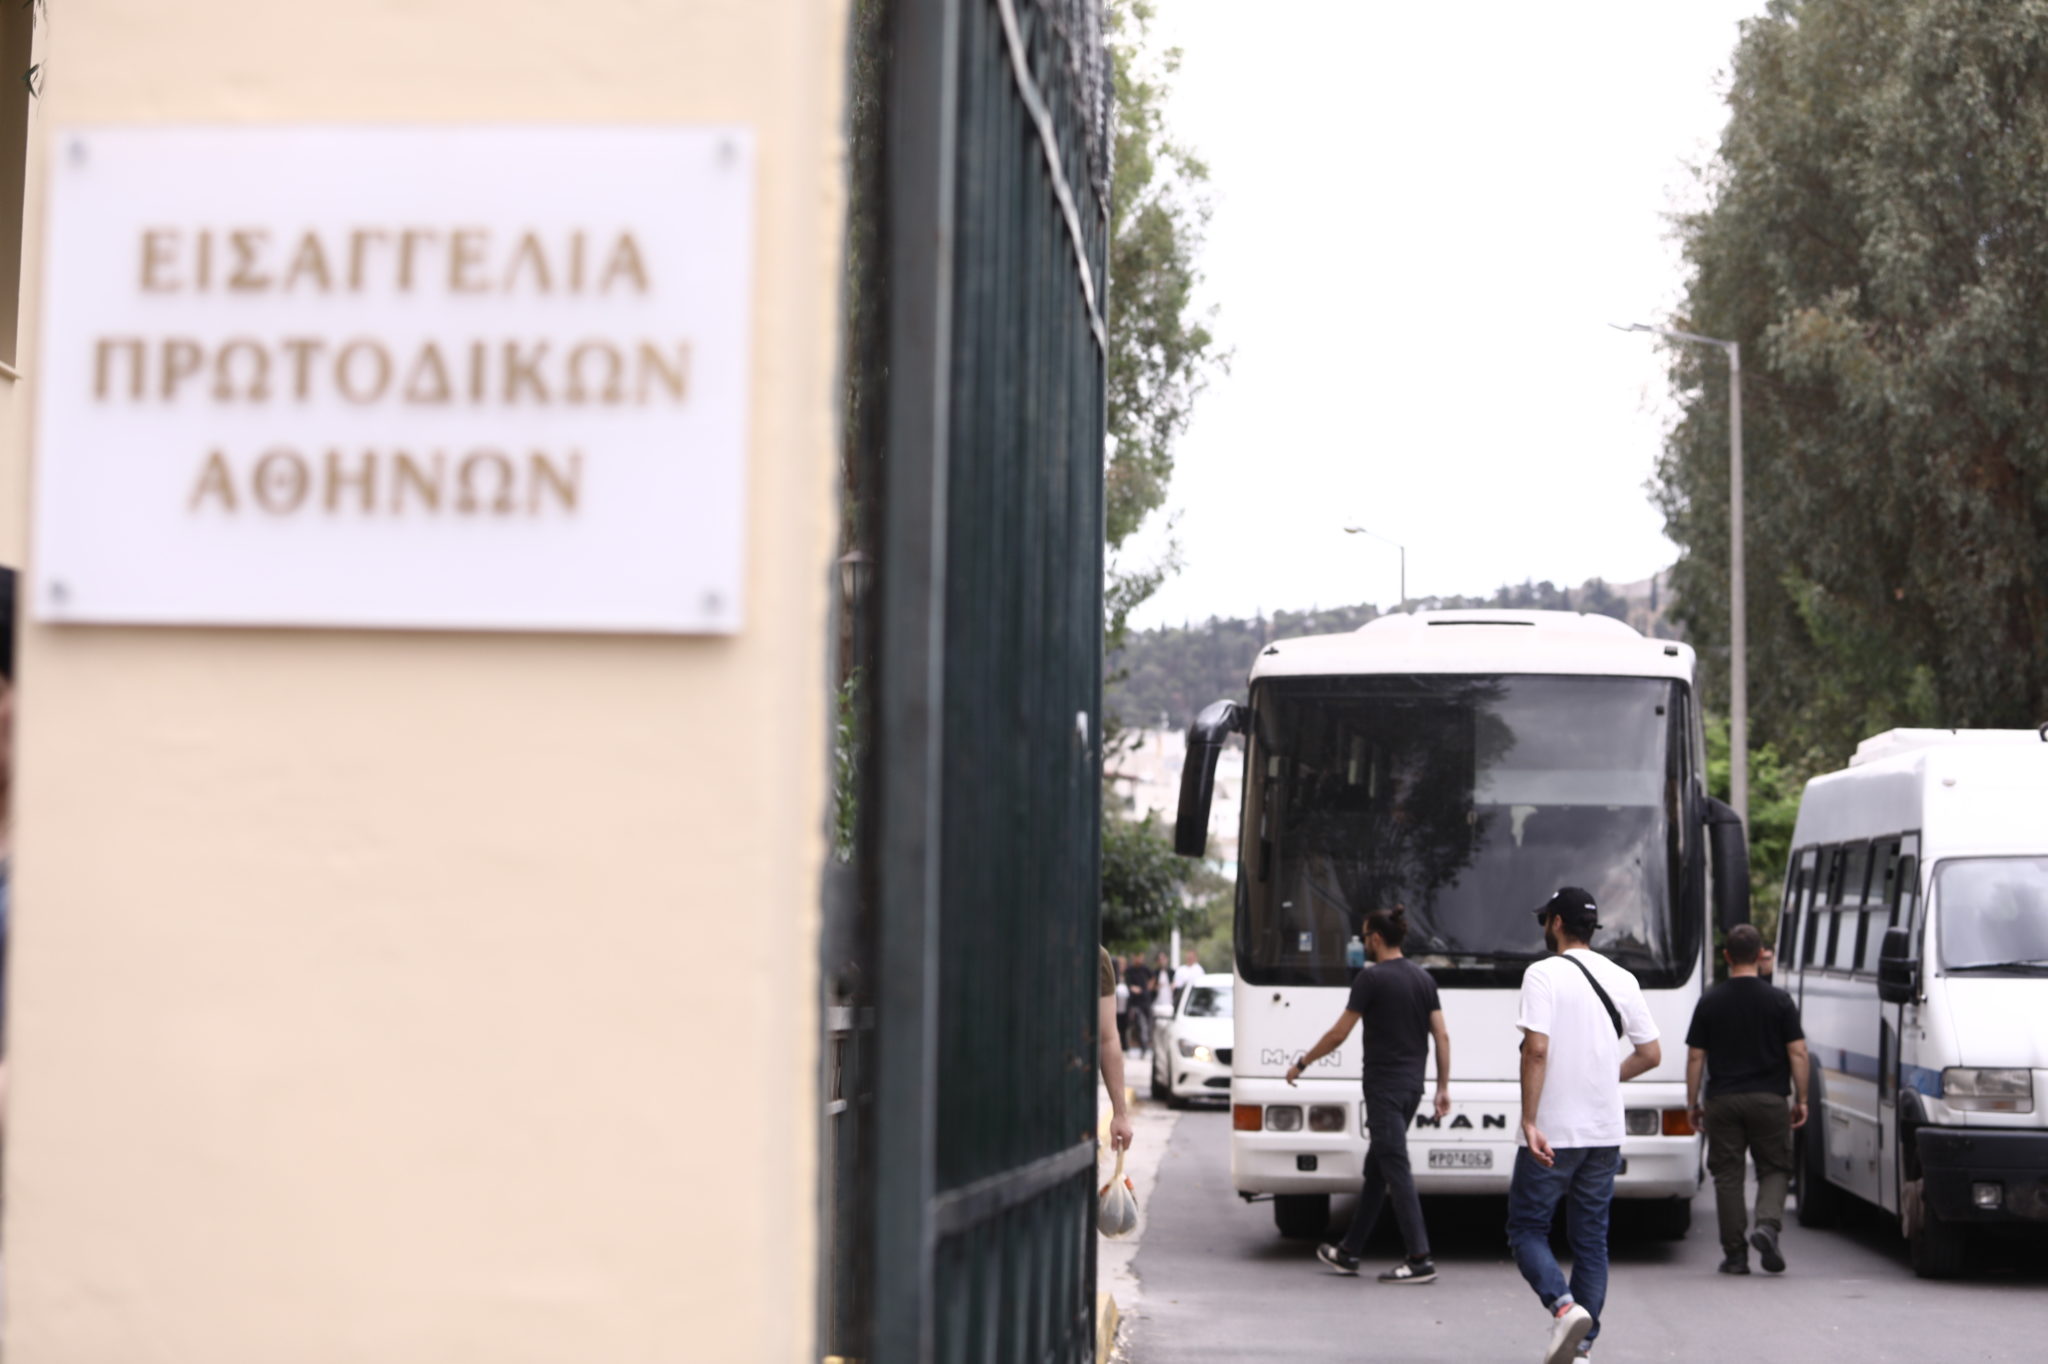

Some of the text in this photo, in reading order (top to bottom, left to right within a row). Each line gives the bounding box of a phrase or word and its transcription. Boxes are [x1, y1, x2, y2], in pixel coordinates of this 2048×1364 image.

[136, 226, 653, 299] ΕΙΣΑΓΓΕΛΙΑ
[89, 334, 692, 411] ΠΡΩΤΟΔΙΚΩΝ
[187, 446, 584, 520] ΑΘΗΝΩΝ
[1416, 1113, 1506, 1129] MAN
